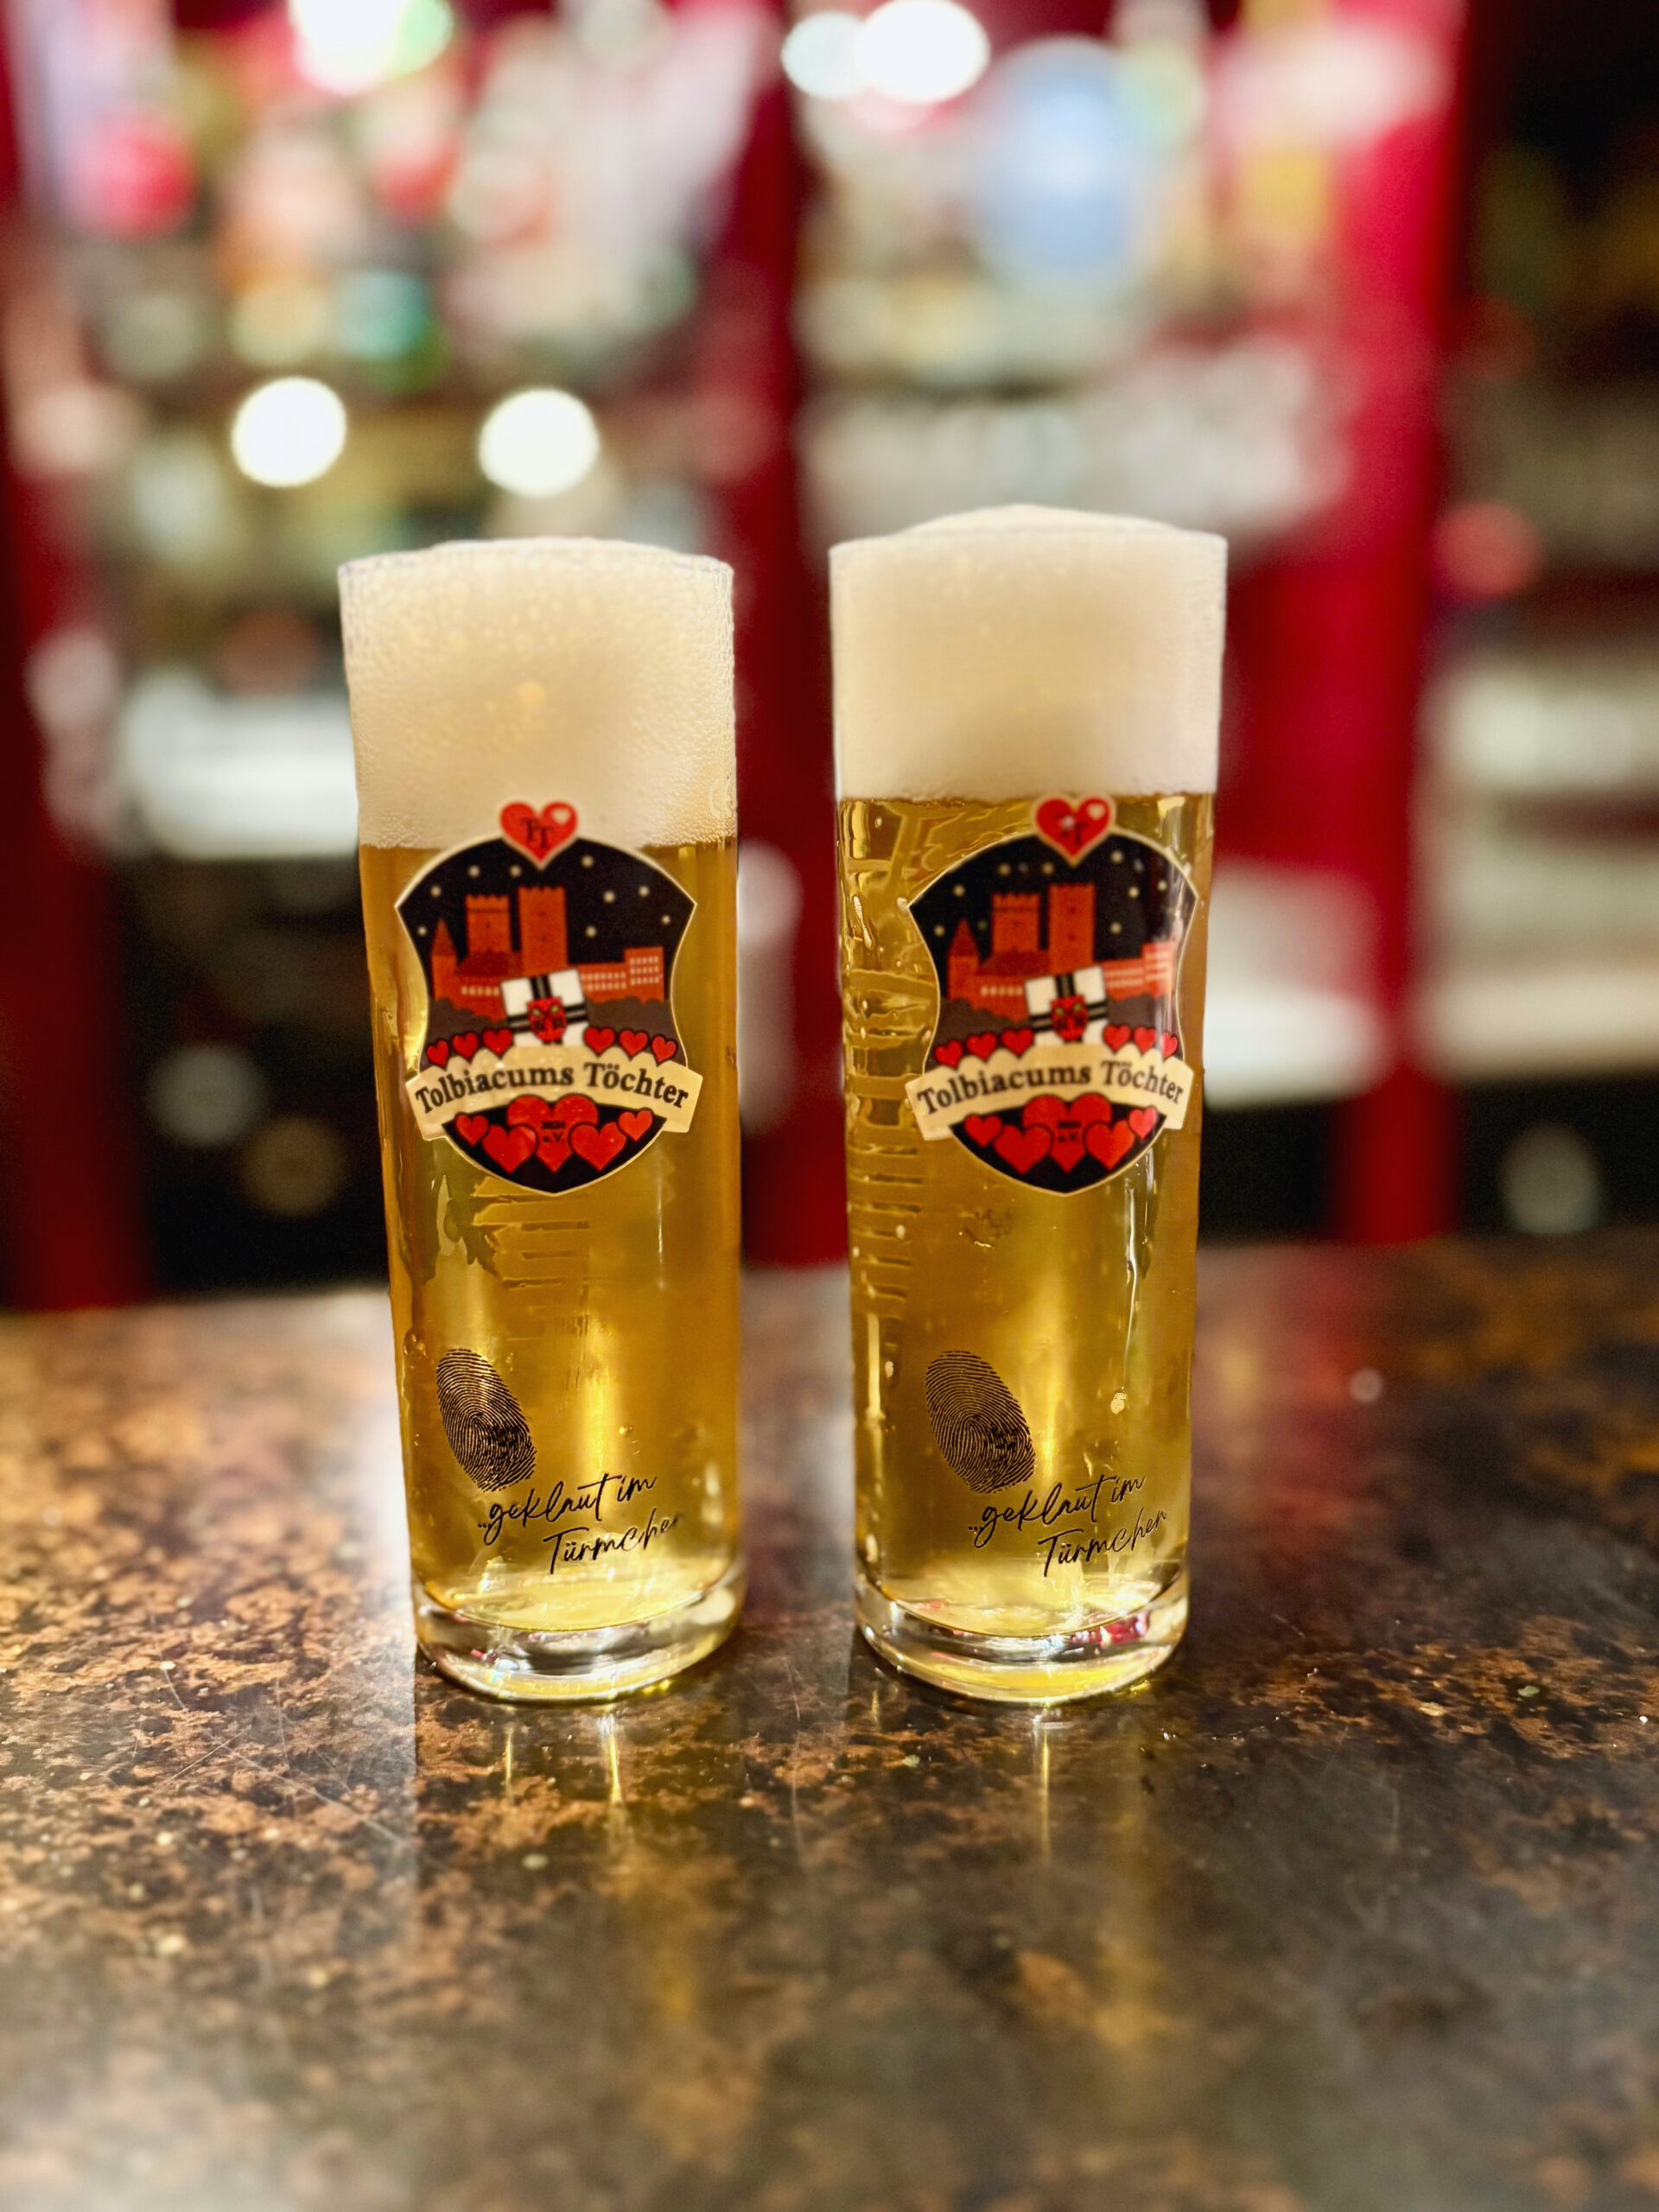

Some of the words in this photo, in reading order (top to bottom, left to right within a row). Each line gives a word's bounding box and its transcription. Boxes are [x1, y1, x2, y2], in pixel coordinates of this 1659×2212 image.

[415, 1065, 575, 1115] Tolbiacums
[584, 1061, 689, 1109] Töchter
[917, 1064, 1092, 1116] Tolbiacums
[1101, 1059, 1185, 1105] Töchter
[617, 1476, 658, 1503] im
[1110, 1475, 1146, 1503] im
[1038, 1506, 1167, 1578] Türmchen
